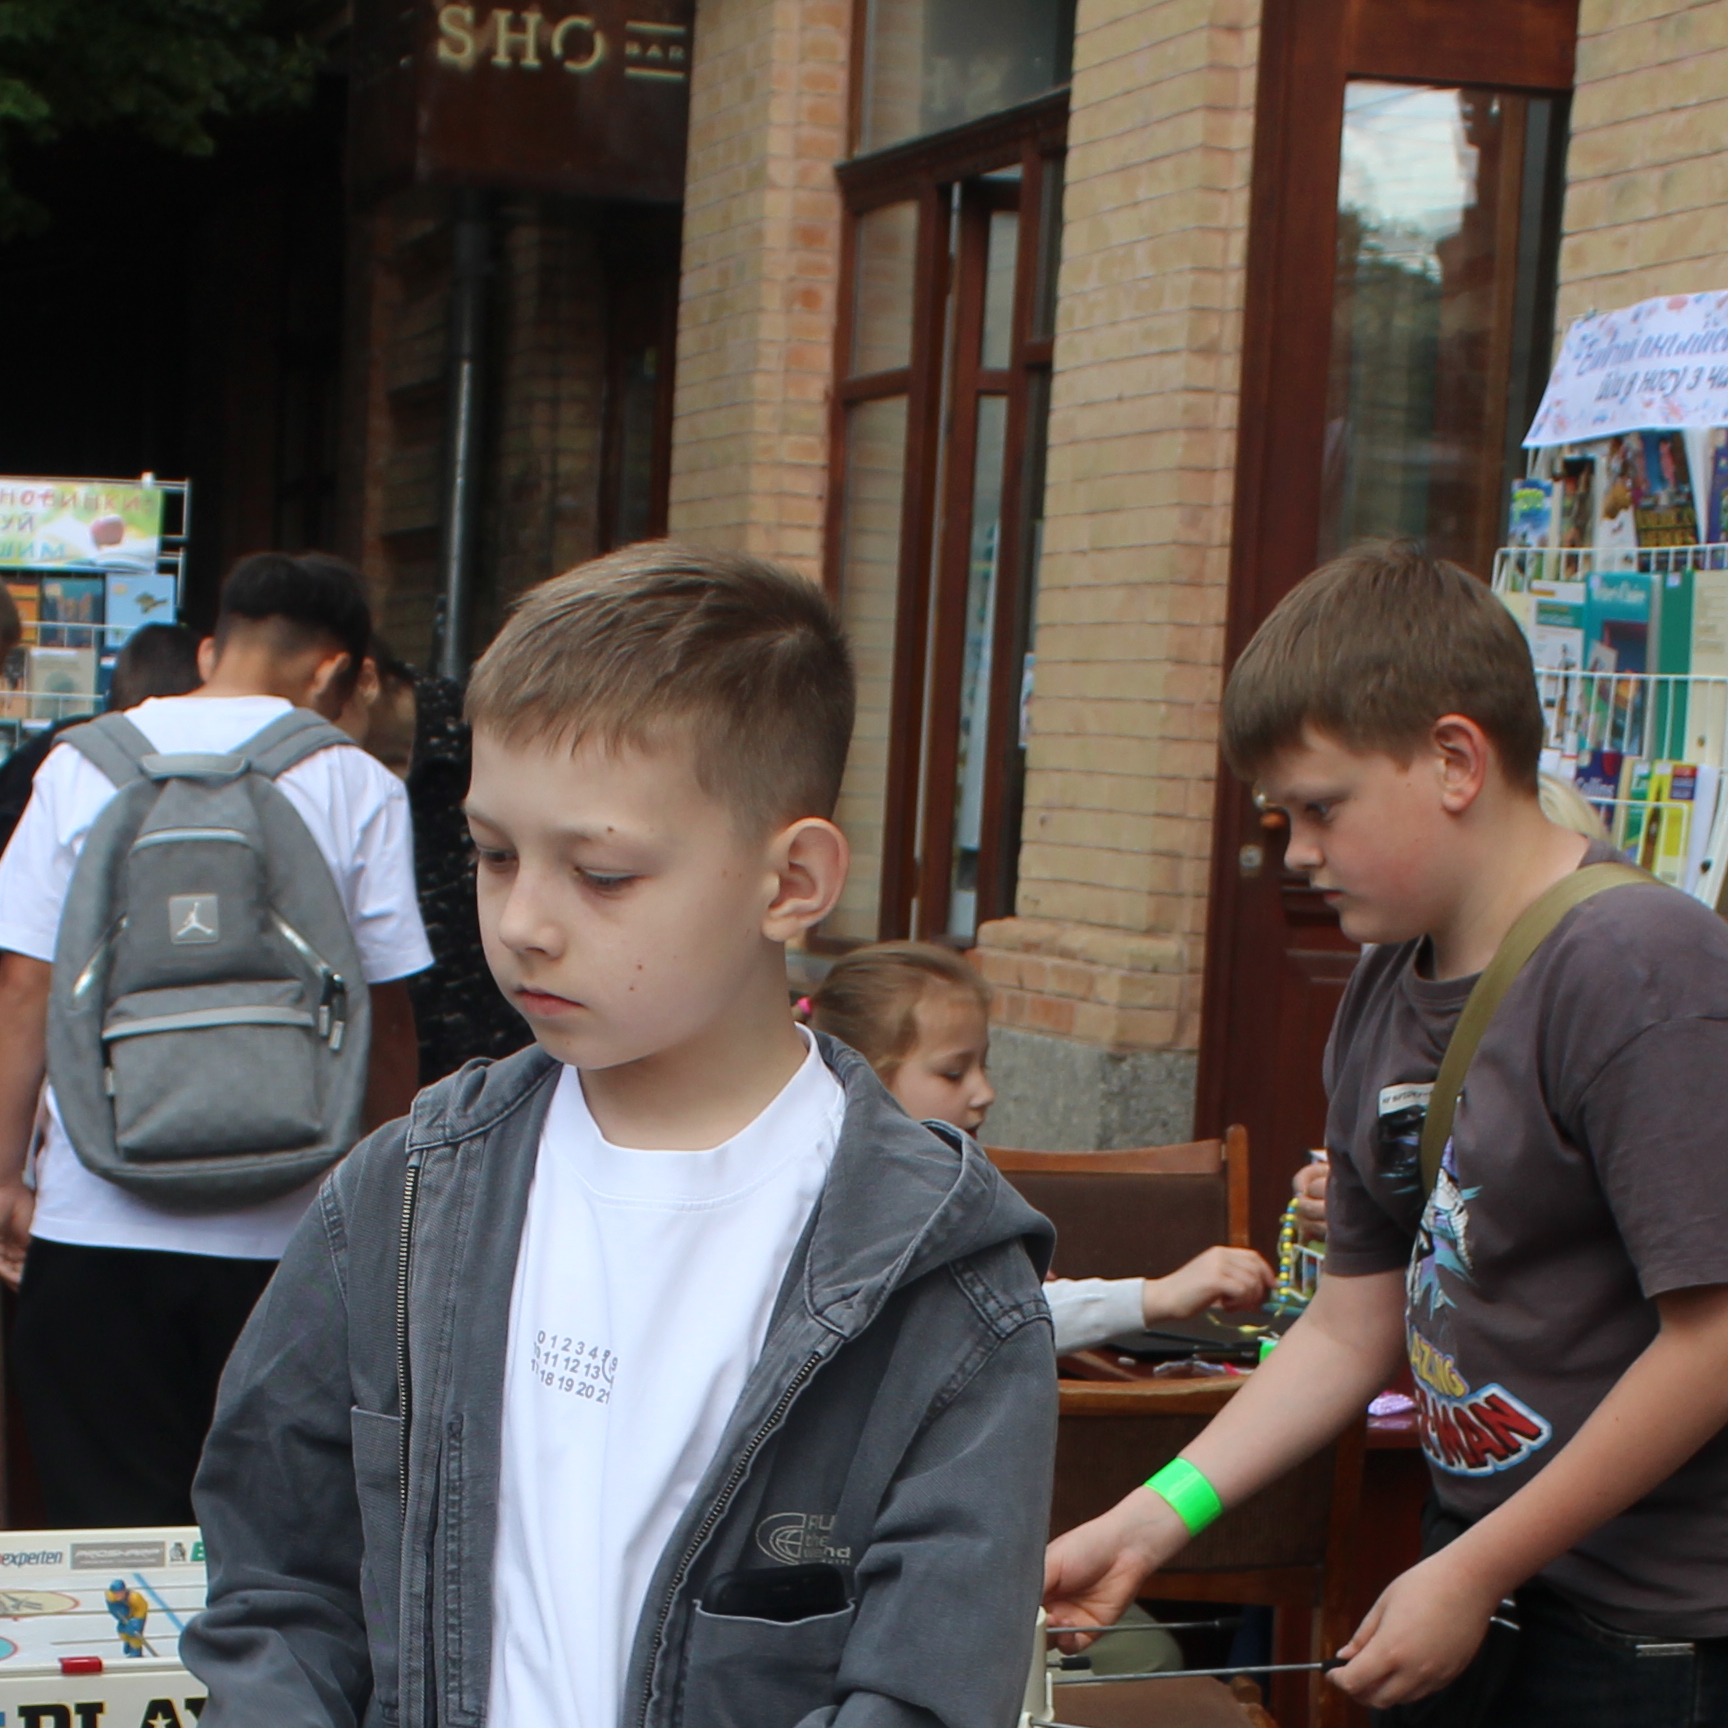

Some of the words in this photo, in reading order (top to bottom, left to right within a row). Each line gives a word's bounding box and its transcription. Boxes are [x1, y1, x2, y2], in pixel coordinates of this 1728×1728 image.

[561, 1337, 572, 1352] 2
[575, 1341, 585, 1356] 3
[558, 1375, 574, 1393] 19
[575, 1381, 595, 1399] 20
